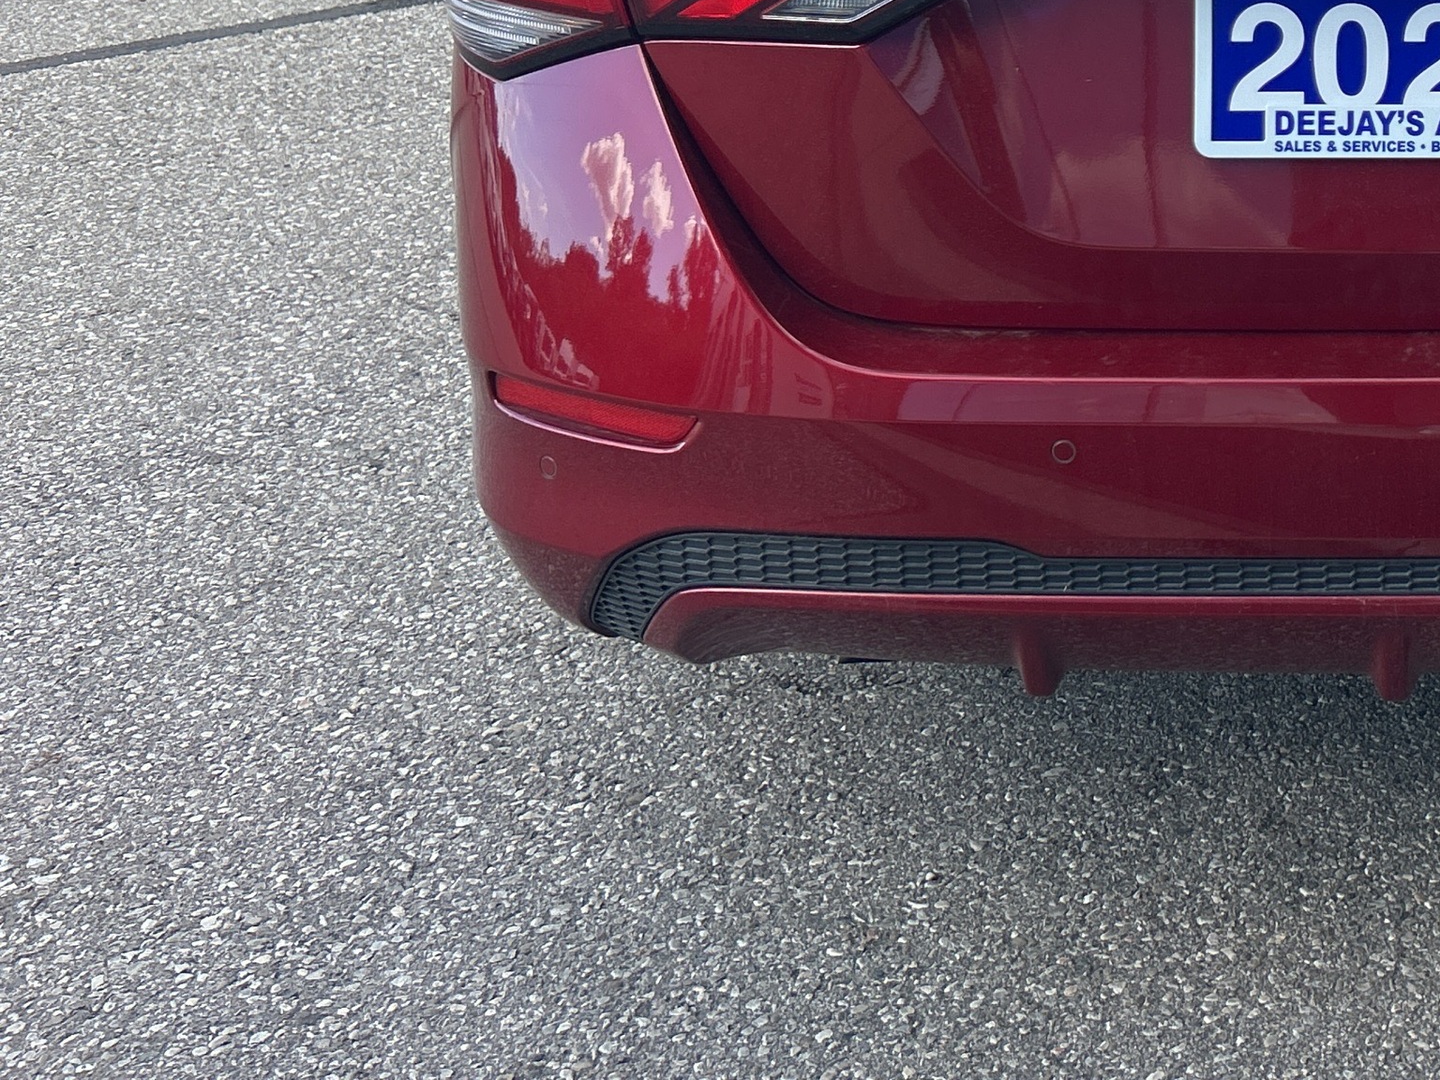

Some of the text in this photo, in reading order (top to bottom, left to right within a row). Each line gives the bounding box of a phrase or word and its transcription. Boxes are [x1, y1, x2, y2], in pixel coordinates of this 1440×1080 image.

[1274, 110, 1425, 136] DEEJAY'S
[1274, 140, 1322, 153] SALES
[1326, 140, 1338, 153] &
[1342, 140, 1416, 153] SERVICES
